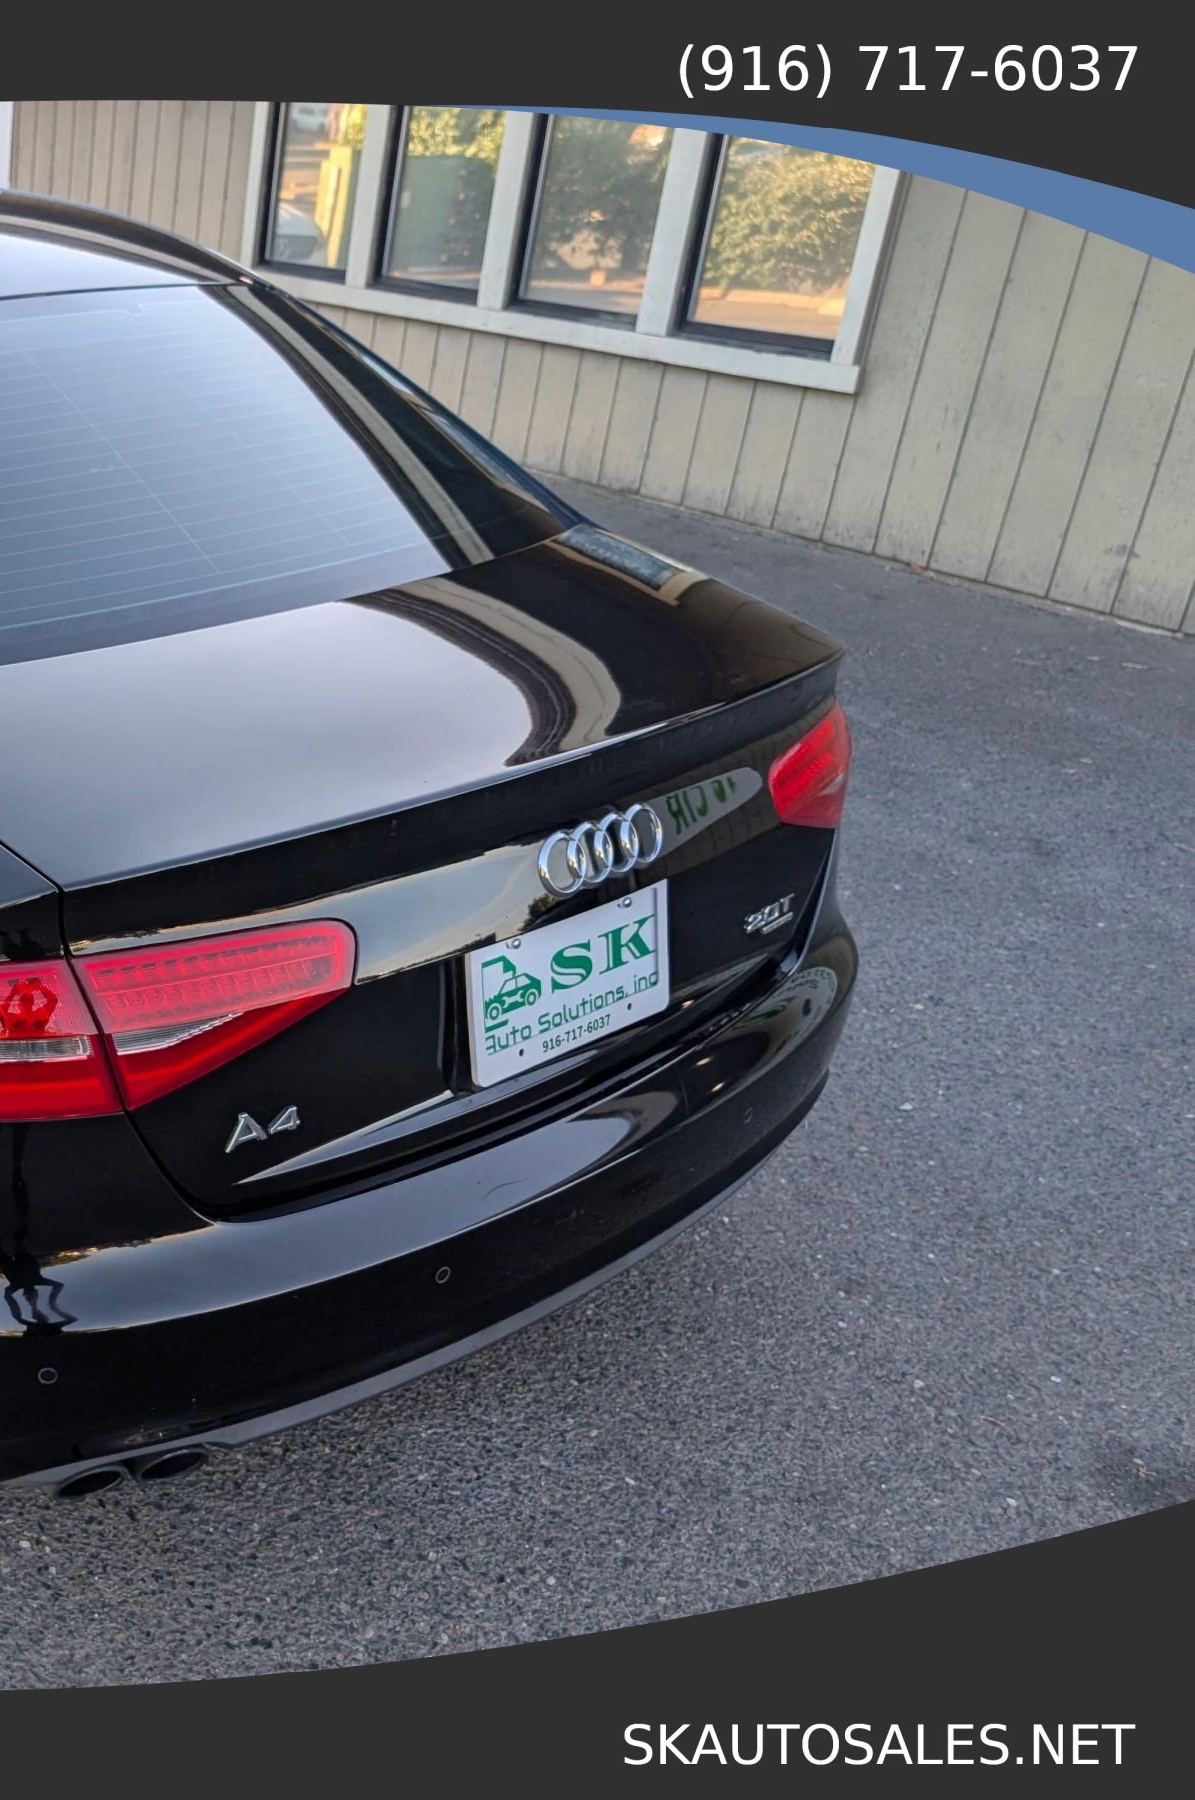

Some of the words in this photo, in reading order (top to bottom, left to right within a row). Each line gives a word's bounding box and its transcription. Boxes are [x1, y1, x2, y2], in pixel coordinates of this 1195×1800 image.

[550, 913, 656, 995] SK
[538, 984, 629, 1035] Solutions,
[542, 1013, 611, 1053] 916-717-6037
[224, 1104, 301, 1153] A4
